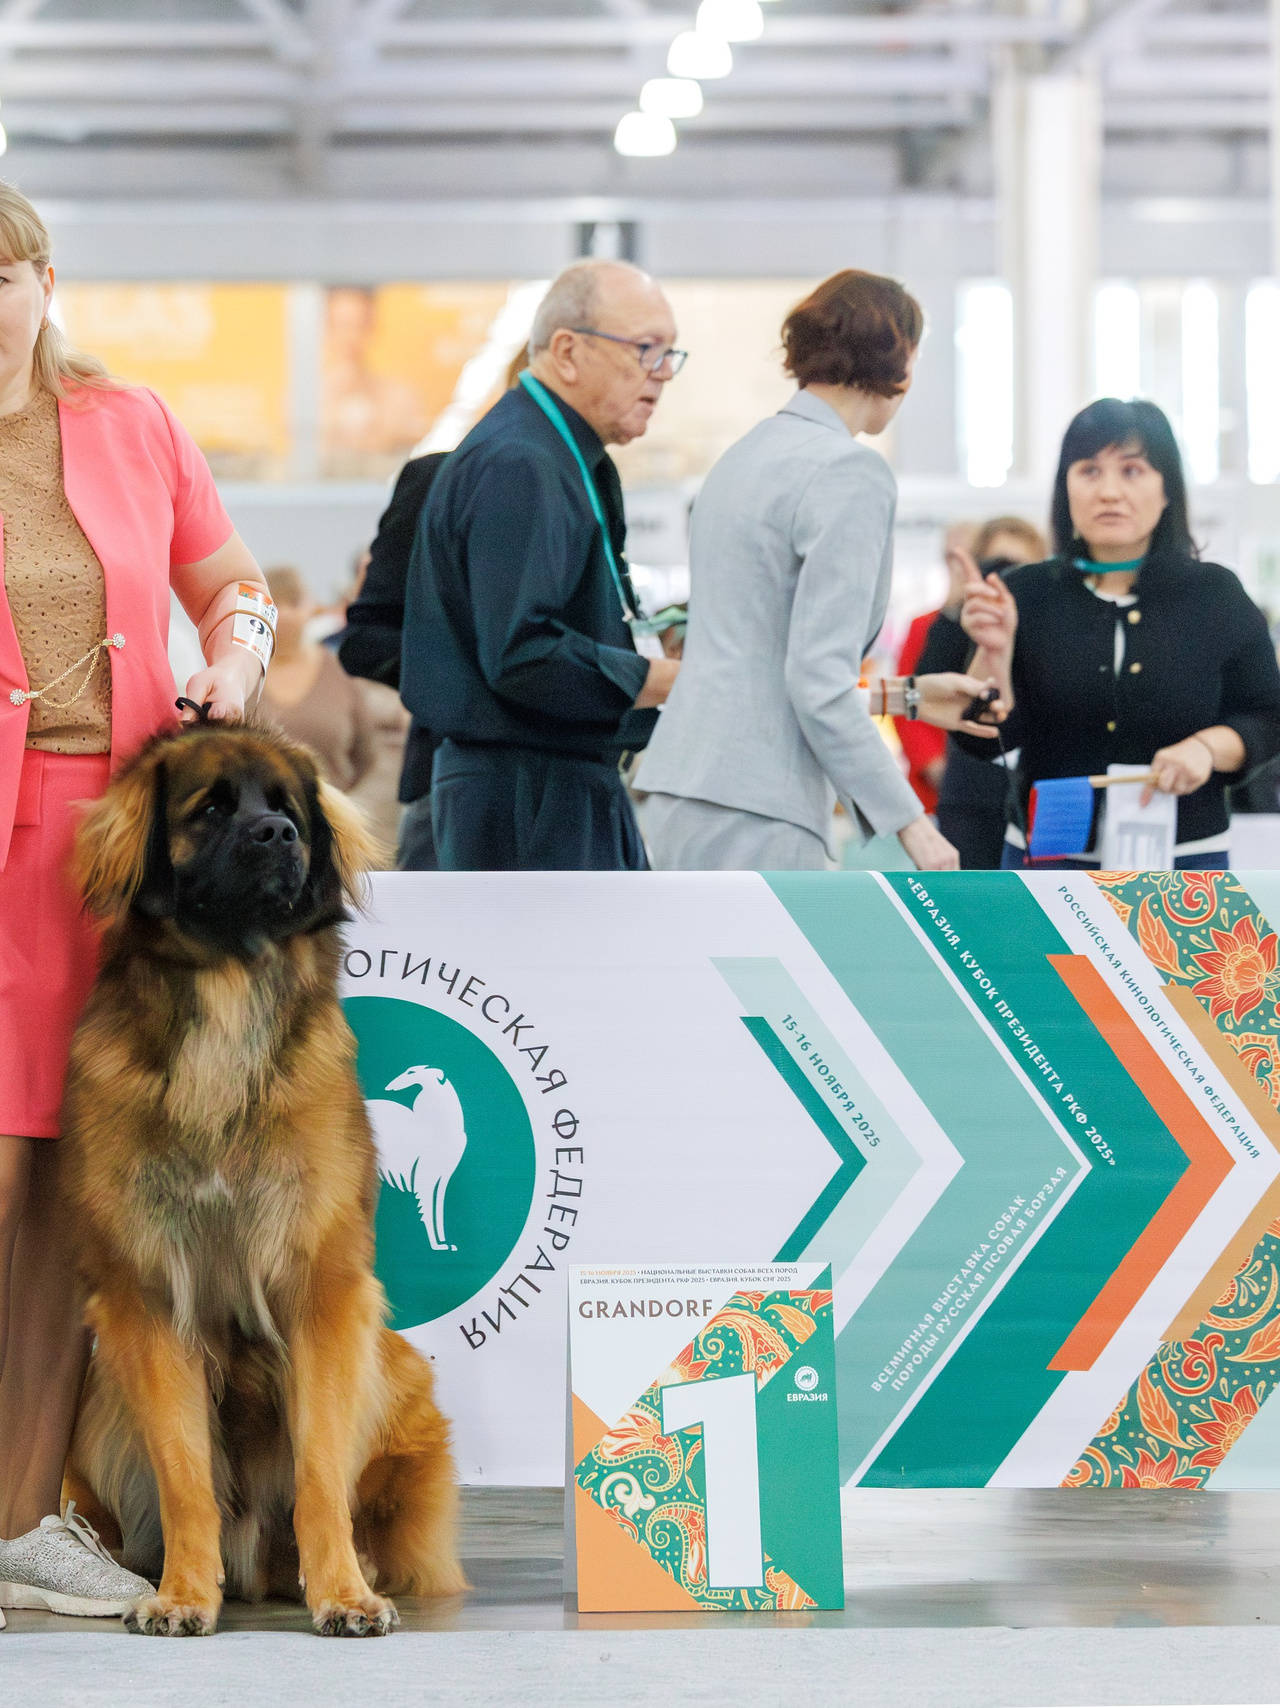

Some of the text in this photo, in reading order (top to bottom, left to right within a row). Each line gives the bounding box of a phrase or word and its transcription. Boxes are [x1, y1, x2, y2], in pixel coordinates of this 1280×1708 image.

[782, 1014, 881, 1147] 15-16 НОЯБРЯ 2025
[959, 950, 999, 1000] КУБОК
[994, 1000, 1064, 1094] ПРЕЗИДЕНТА
[1062, 1093, 1088, 1124] РКФ
[1085, 1126, 1116, 1166] 2025»
[1058, 885, 1261, 1159] РОССИЙСКАЯ КИНОЛОГИЧЕСКАЯ ФЕДЕРАЦИЯ
[459, 1108, 584, 1350] ФЕДЕРАЦИЯ
[578, 1298, 713, 1319] GRANDORF
[633, 1277, 675, 1285] ПРЕЗИДЕНТА
[641, 1268, 697, 1276] НАЦИОНАЛЬНЫЕ
[775, 1267, 798, 1275] ПОРОД
[870, 1195, 1027, 1392] ВСЕМИРНАЯ ВЫСТАВКА СОБАК
[891, 1166, 1067, 1391] ПОРОДЫ РУССКАЯ ПСОВАЯ БОРЗАЯ
[662, 1371, 764, 1588] 1
[786, 1393, 828, 1402] ЕВРАЗИЯ
